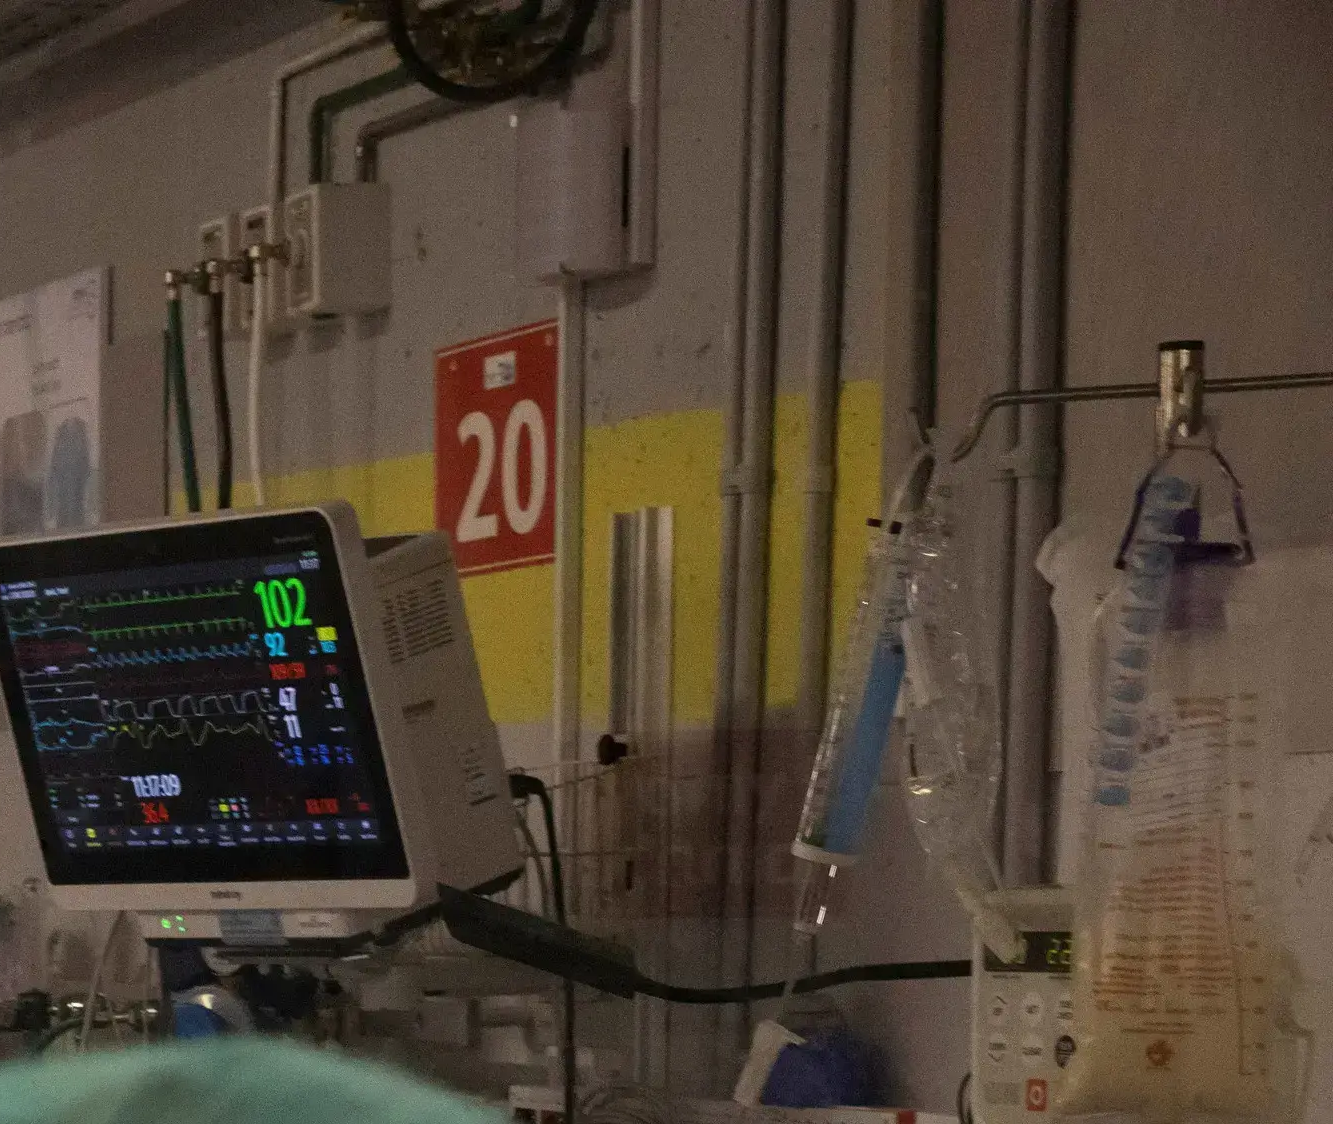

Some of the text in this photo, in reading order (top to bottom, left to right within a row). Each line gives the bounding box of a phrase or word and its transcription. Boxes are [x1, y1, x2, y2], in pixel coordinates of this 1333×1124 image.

[457, 399, 547, 543] 20
[254, 578, 313, 628] 102
[264, 632, 289, 657] 92
[284, 714, 303, 738] 11
